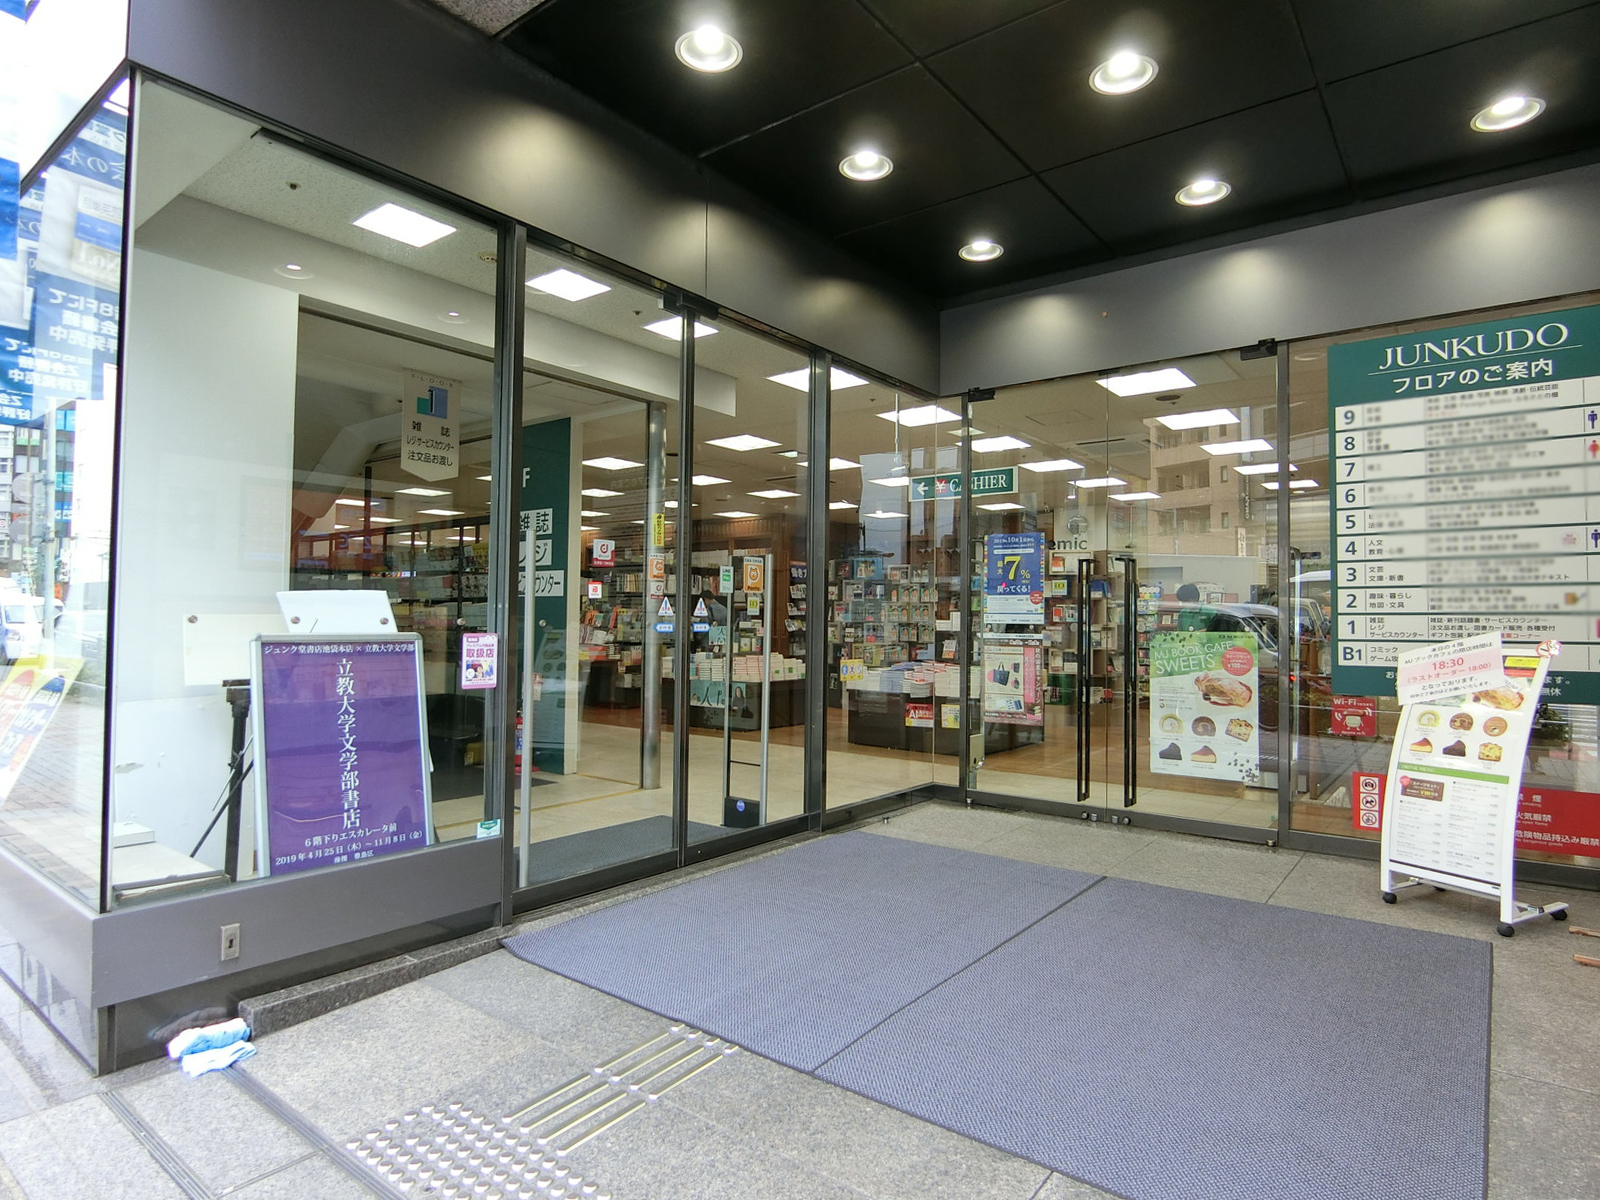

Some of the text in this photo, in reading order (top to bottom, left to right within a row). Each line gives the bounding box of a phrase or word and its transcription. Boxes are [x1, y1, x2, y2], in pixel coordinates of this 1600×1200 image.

[1378, 323, 1569, 370] JUNKUDO
[1393, 359, 1553, 394] フロアのご案内
[1343, 410, 1355, 425] 9
[1344, 437, 1355, 451] 8
[408, 450, 453, 467] 注文品お渡し
[1344, 462, 1356, 477] 7
[949, 474, 1007, 493] CHIER
[1344, 489, 1356, 503] 6
[1345, 514, 1356, 530] 5
[1345, 541, 1357, 556] 4
[1004, 555, 1021, 580] 7
[1020, 569, 1031, 579] %
[1346, 567, 1357, 582] 3
[1346, 594, 1357, 608] 2
[1369, 592, 1412, 600] 趣味・暮らし
[1347, 620, 1355, 635] 1
[264, 644, 354, 654] ジュンク堂書店池袋本店
[365, 643, 416, 653] 立教大学文学部
[466, 648, 495, 658] 取扱店
[1154, 641, 1234, 660] MJ BOOK CAFE
[1342, 646, 1362, 661] B1
[1155, 653, 1216, 675] SWEETS
[1432, 657, 1464, 671] 18:30
[1333, 697, 1357, 706] Wi-Fi
[335, 657, 361, 830] 立教大学文学部書店
